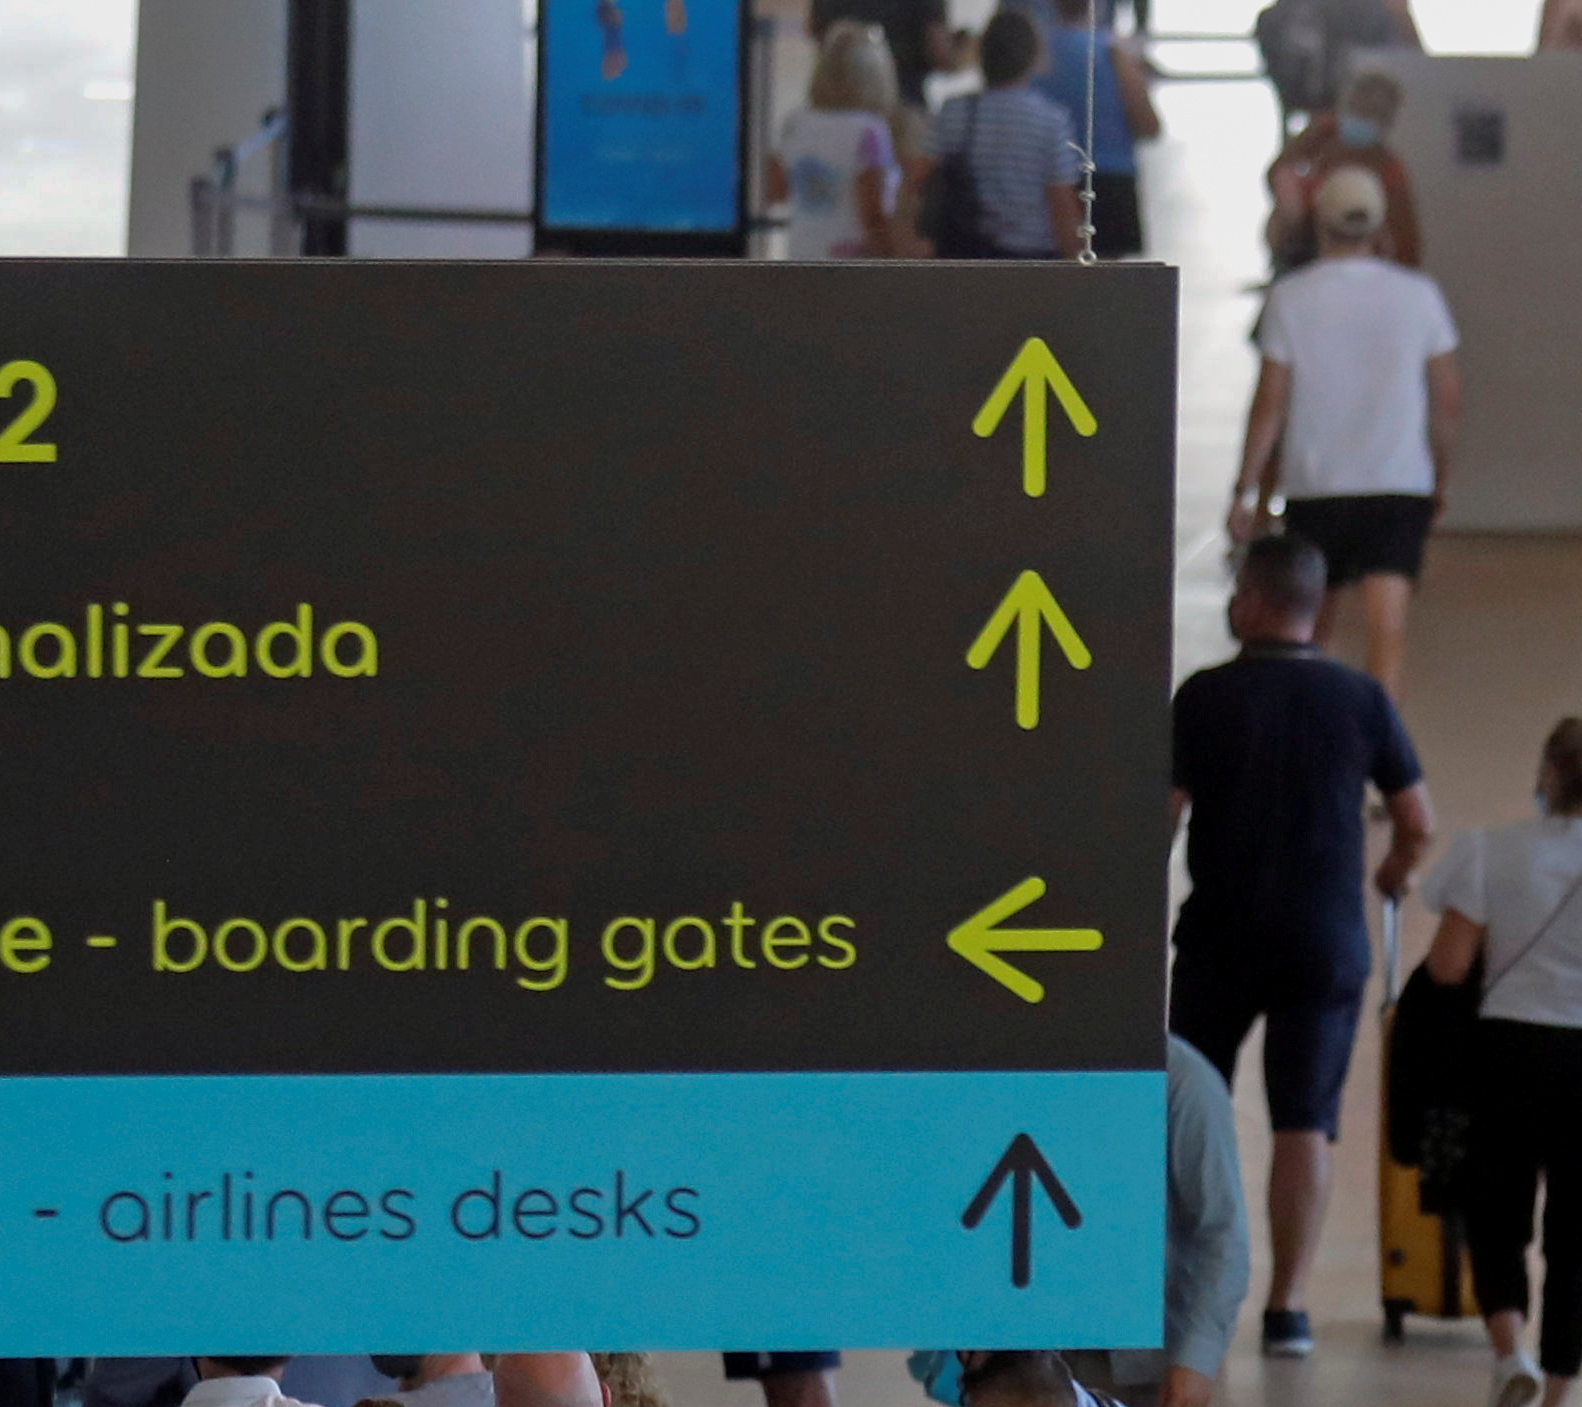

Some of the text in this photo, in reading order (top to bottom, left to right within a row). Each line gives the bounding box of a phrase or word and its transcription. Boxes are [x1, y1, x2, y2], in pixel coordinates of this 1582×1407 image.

[152, 896, 569, 992] boarding
[600, 900, 858, 992] gates
[97, 1169, 417, 1244] airlines
[449, 1168, 702, 1242] desks
